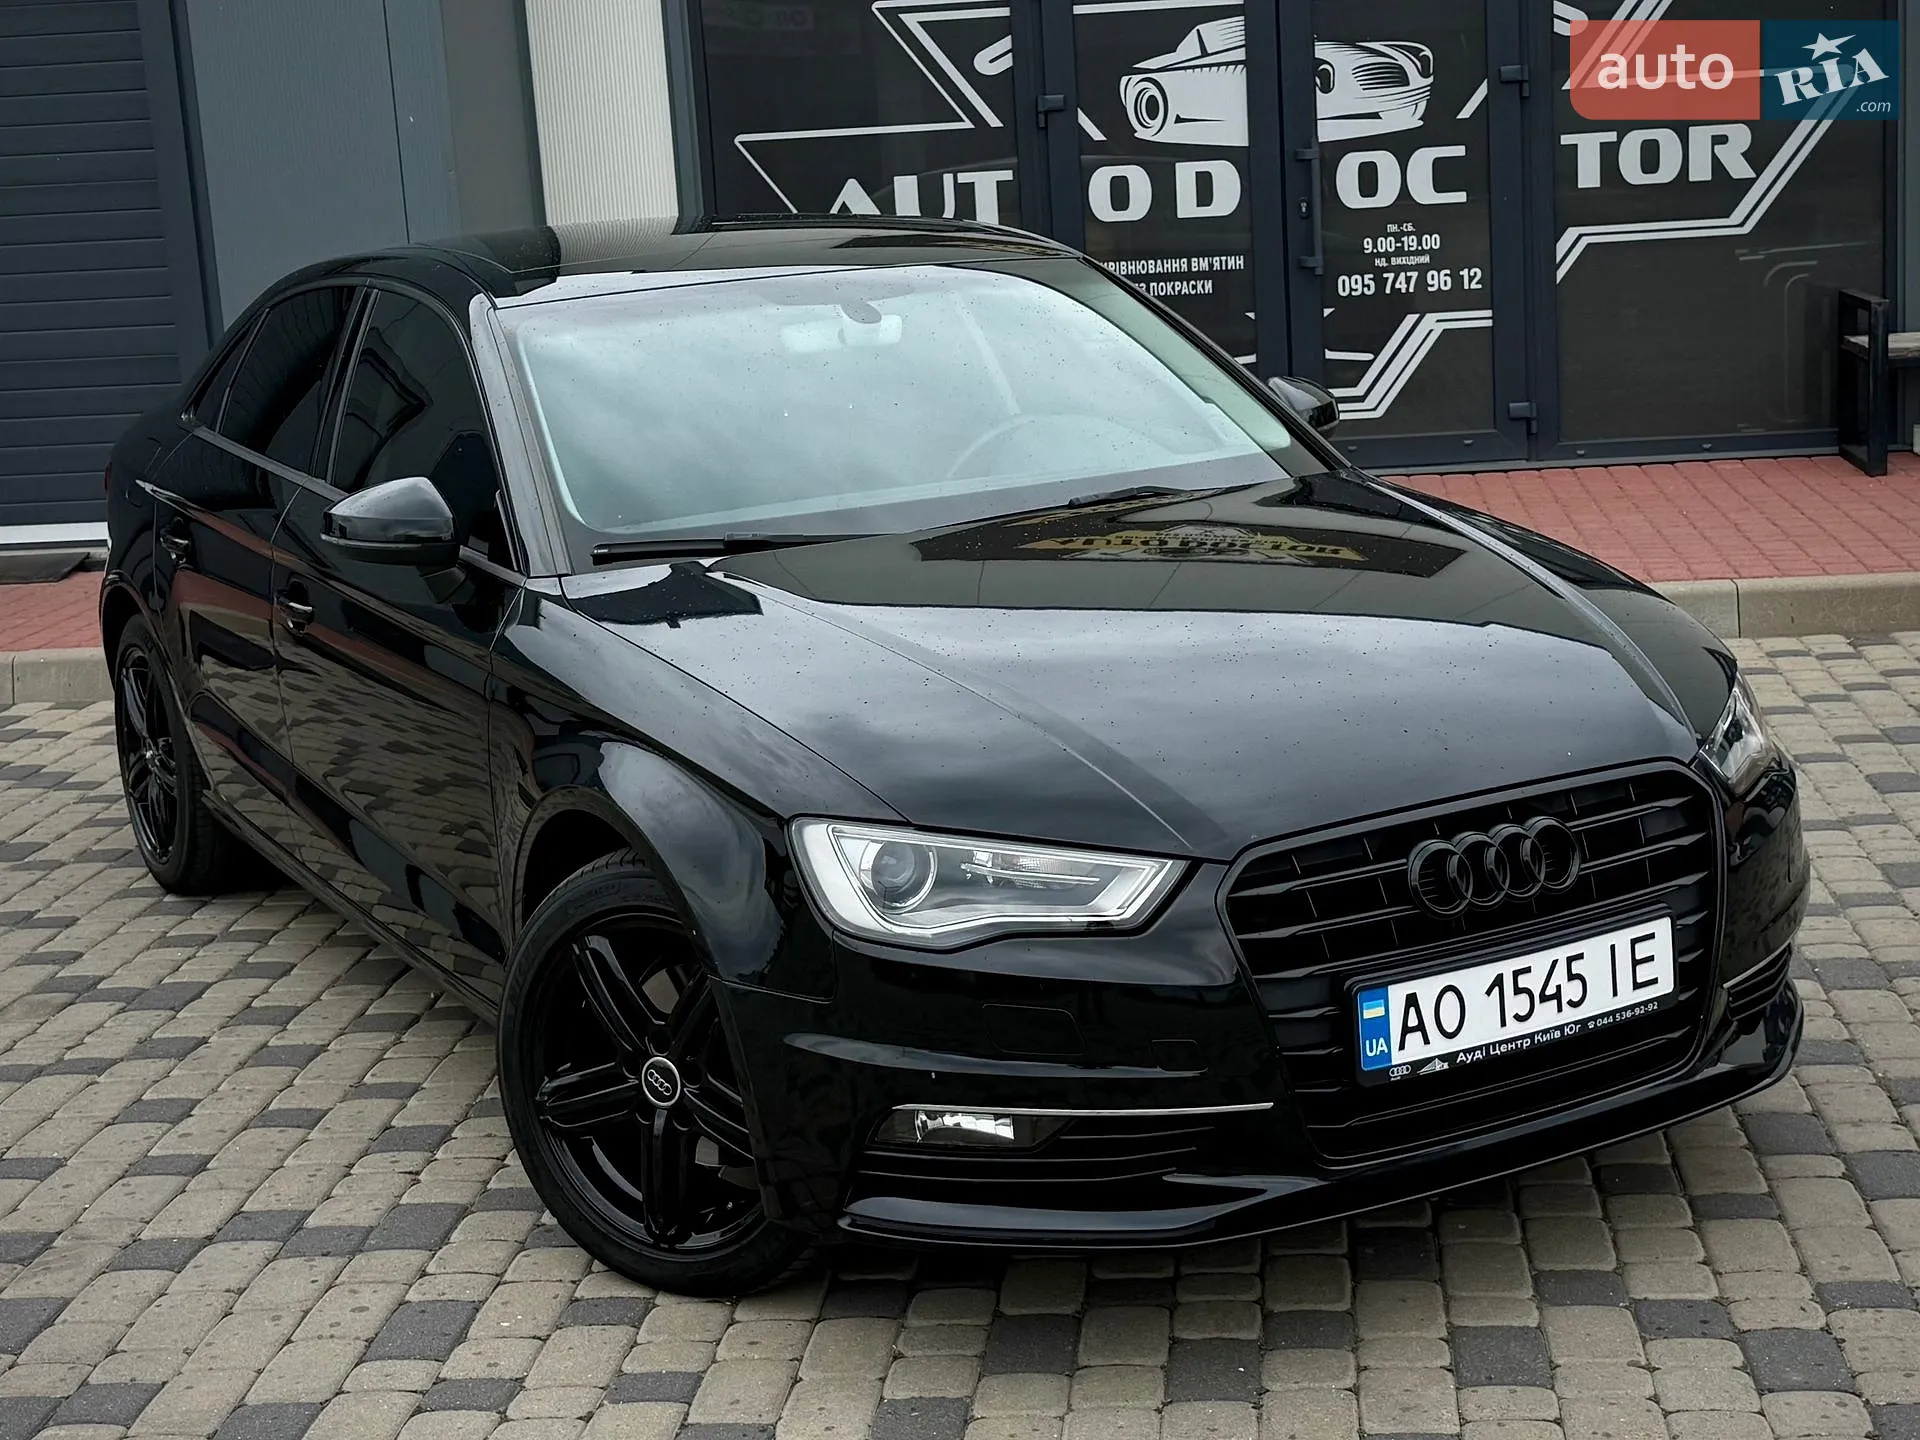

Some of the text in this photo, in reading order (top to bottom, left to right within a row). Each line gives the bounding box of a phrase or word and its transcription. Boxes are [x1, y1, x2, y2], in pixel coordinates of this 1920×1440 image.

[1363, 233, 1441, 254] 9.00-19.00
[1191, 255, 1245, 272] ВМ'ЯТИН
[1150, 279, 1214, 296] ПОКРАСКИ
[1337, 267, 1483, 297] 095 747 96 12
[1398, 931, 1659, 1052] AO 1545 IE
[1456, 1001, 1659, 1065] Ауді Центр Київ Юг 044 536-92-92
[1365, 1037, 1389, 1057] UA
